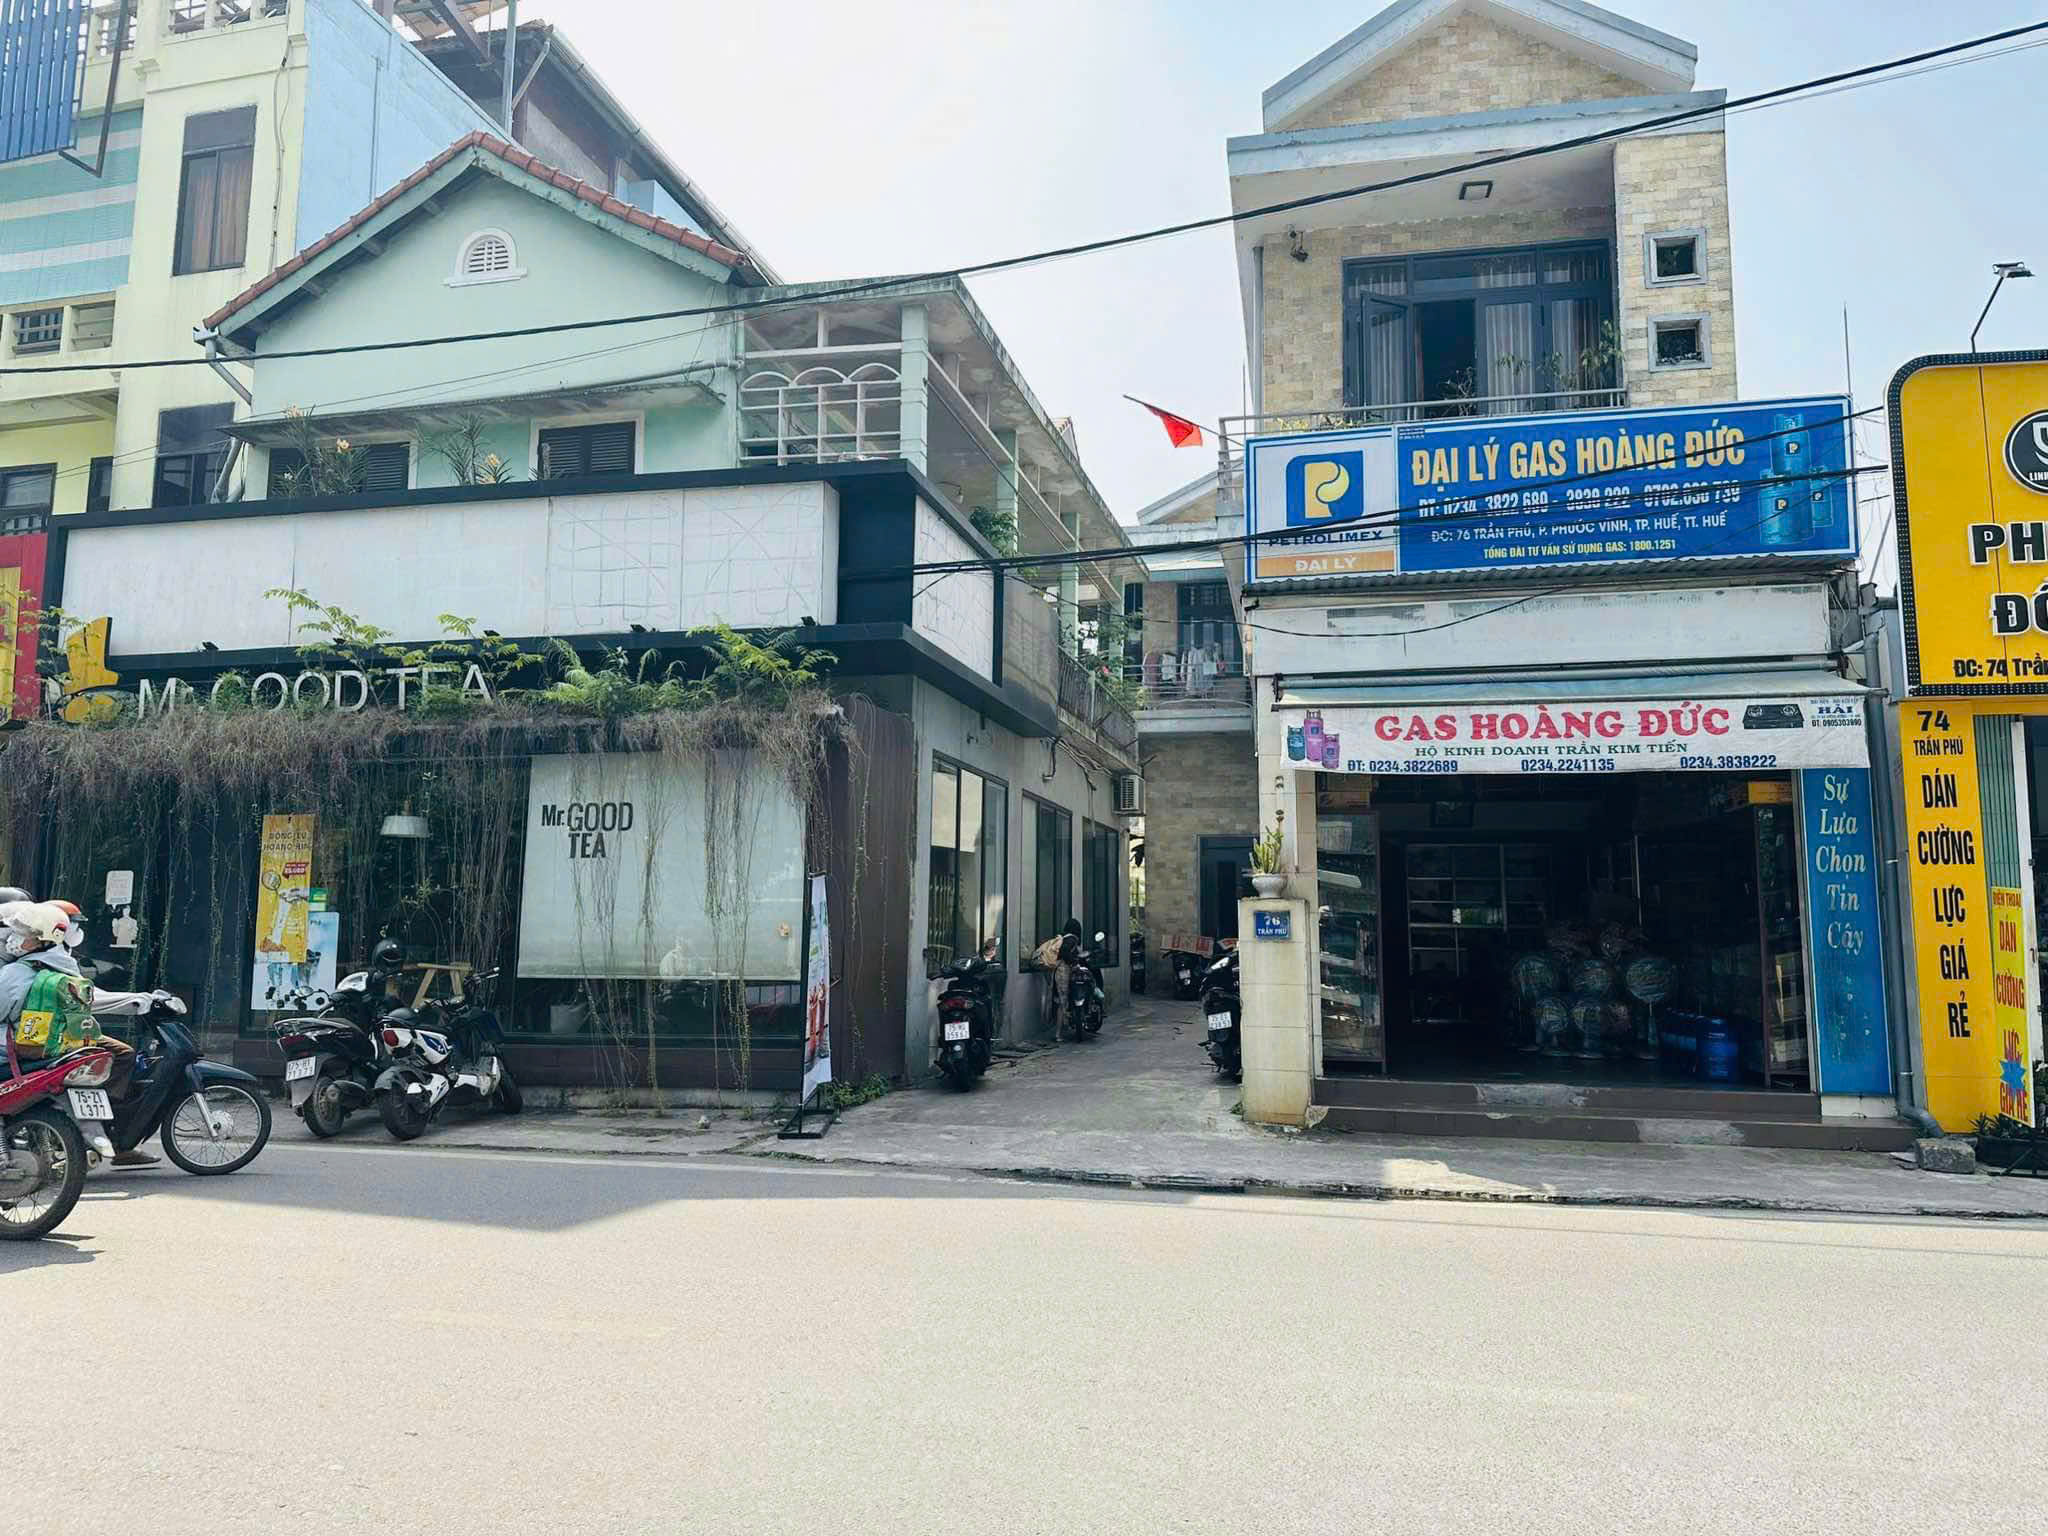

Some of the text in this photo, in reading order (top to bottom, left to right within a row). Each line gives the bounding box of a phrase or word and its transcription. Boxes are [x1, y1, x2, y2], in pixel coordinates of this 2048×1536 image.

[1412, 419, 1745, 492] ĐẠI LÝ GAS HOÀNG ĐỨC
[1457, 529, 1471, 541] 76
[1635, 518, 1652, 531] TP.
[1654, 512, 1680, 531] HUẾ,
[1703, 510, 1728, 527] HUẾ
[1605, 541, 1627, 552] GAS:
[1630, 538, 1676, 551] 1800.1251
[1953, 658, 1983, 677] ĐC:
[1986, 658, 2007, 677] 74
[1374, 701, 1729, 741] GAS HOÀNG ĐỨC
[1917, 710, 1950, 732] 74
[1347, 754, 1777, 773] ĐT: 0234.3822689 0234.2241135 0234.3838222
[1415, 746, 1438, 758] HỘ
[1445, 746, 1485, 756] KINH
[1492, 745, 1549, 756] DOANH
[1608, 743, 1645, 754] KIM
[1647, 739, 1688, 753] TIẾN
[1823, 774, 1850, 804] Sự
[1921, 767, 1958, 808] DÁN
[567, 802, 633, 831] GOOD
[1819, 808, 1859, 842] Lựa
[568, 833, 606, 858] TEA
[1917, 823, 1976, 865] CƯỜNG
[1815, 845, 1866, 879] Chọn
[1827, 883, 1860, 911] Tin
[1933, 884, 1966, 927] LỰC
[1264, 916, 1281, 926] 76
[1827, 921, 1864, 955] Cậy
[2000, 915, 2017, 953] DÁN
[1940, 938, 1970, 980] GIÁ
[1996, 968, 2025, 1010] CƯỜNG
[1947, 990, 1971, 1038] RẺ
